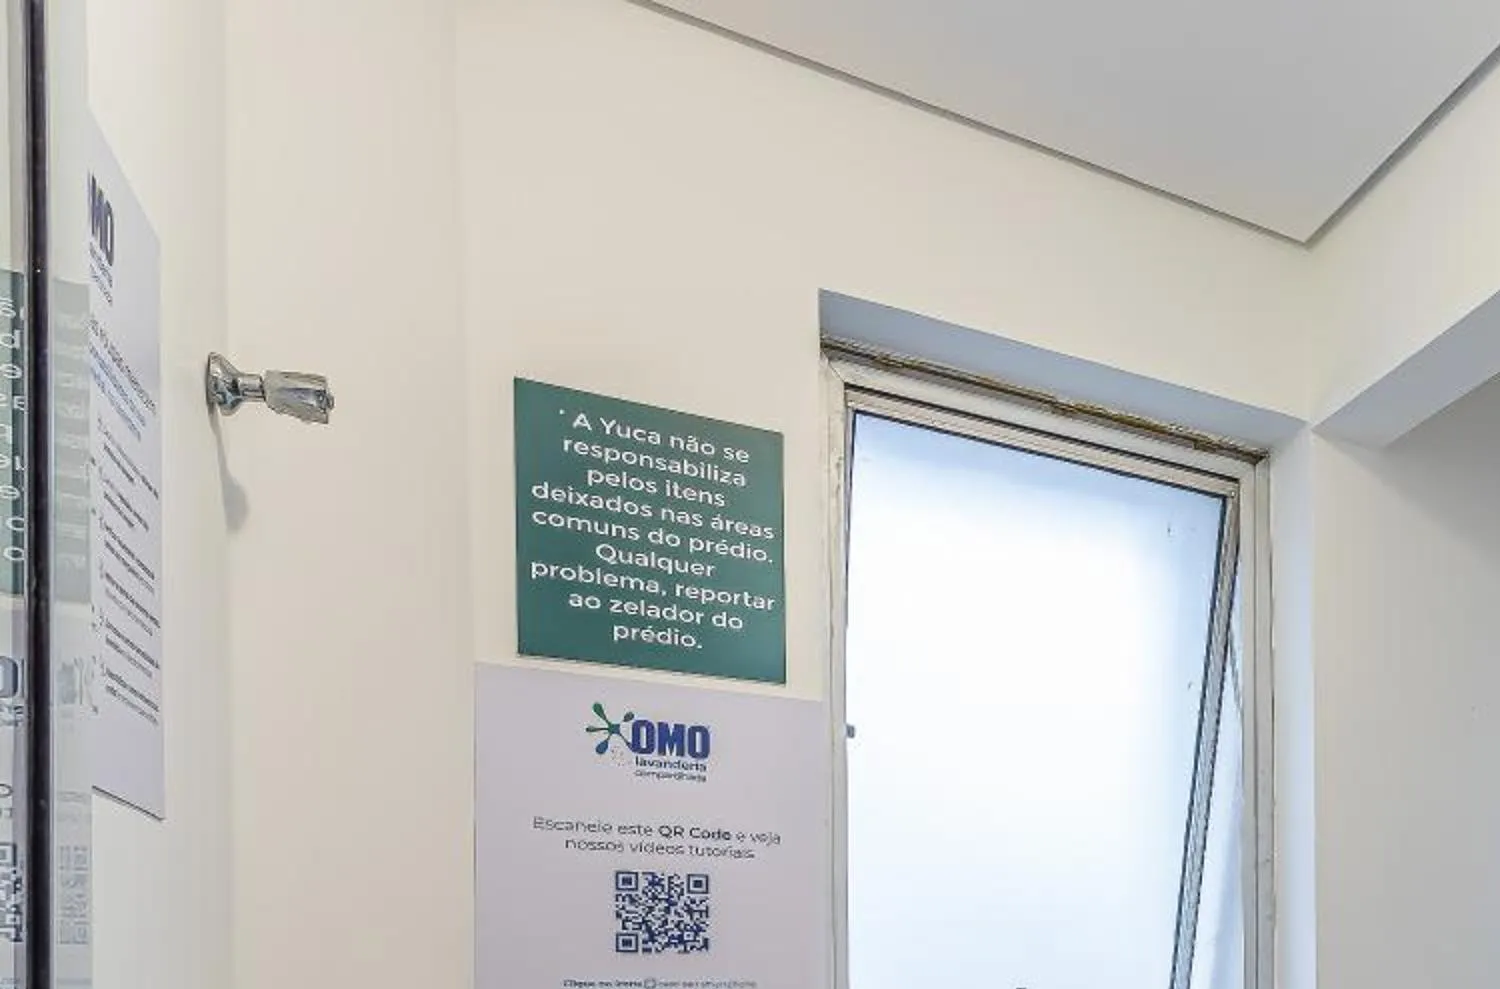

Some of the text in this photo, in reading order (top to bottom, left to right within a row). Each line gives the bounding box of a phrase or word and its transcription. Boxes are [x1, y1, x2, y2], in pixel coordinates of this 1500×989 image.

[88, 170, 115, 268] MO
[572, 413, 750, 463] A Yuca não se
[563, 436, 747, 487] responsabiliza
[587, 468, 726, 507] pelos itens
[531, 481, 775, 540] deixados nas áreas
[531, 510, 773, 565] comuns do prédio.
[595, 543, 716, 577] Qualquer
[568, 592, 744, 630] ao zelador do
[675, 582, 775, 611] reportar
[613, 622, 703, 649] prédio.
[631, 718, 711, 760] OMO
[635, 755, 707, 772] lavanderia
[533, 816, 781, 846] Escaneie este QR Code e veja
[565, 838, 625, 853] nossos
[629, 839, 685, 856] vídeos
